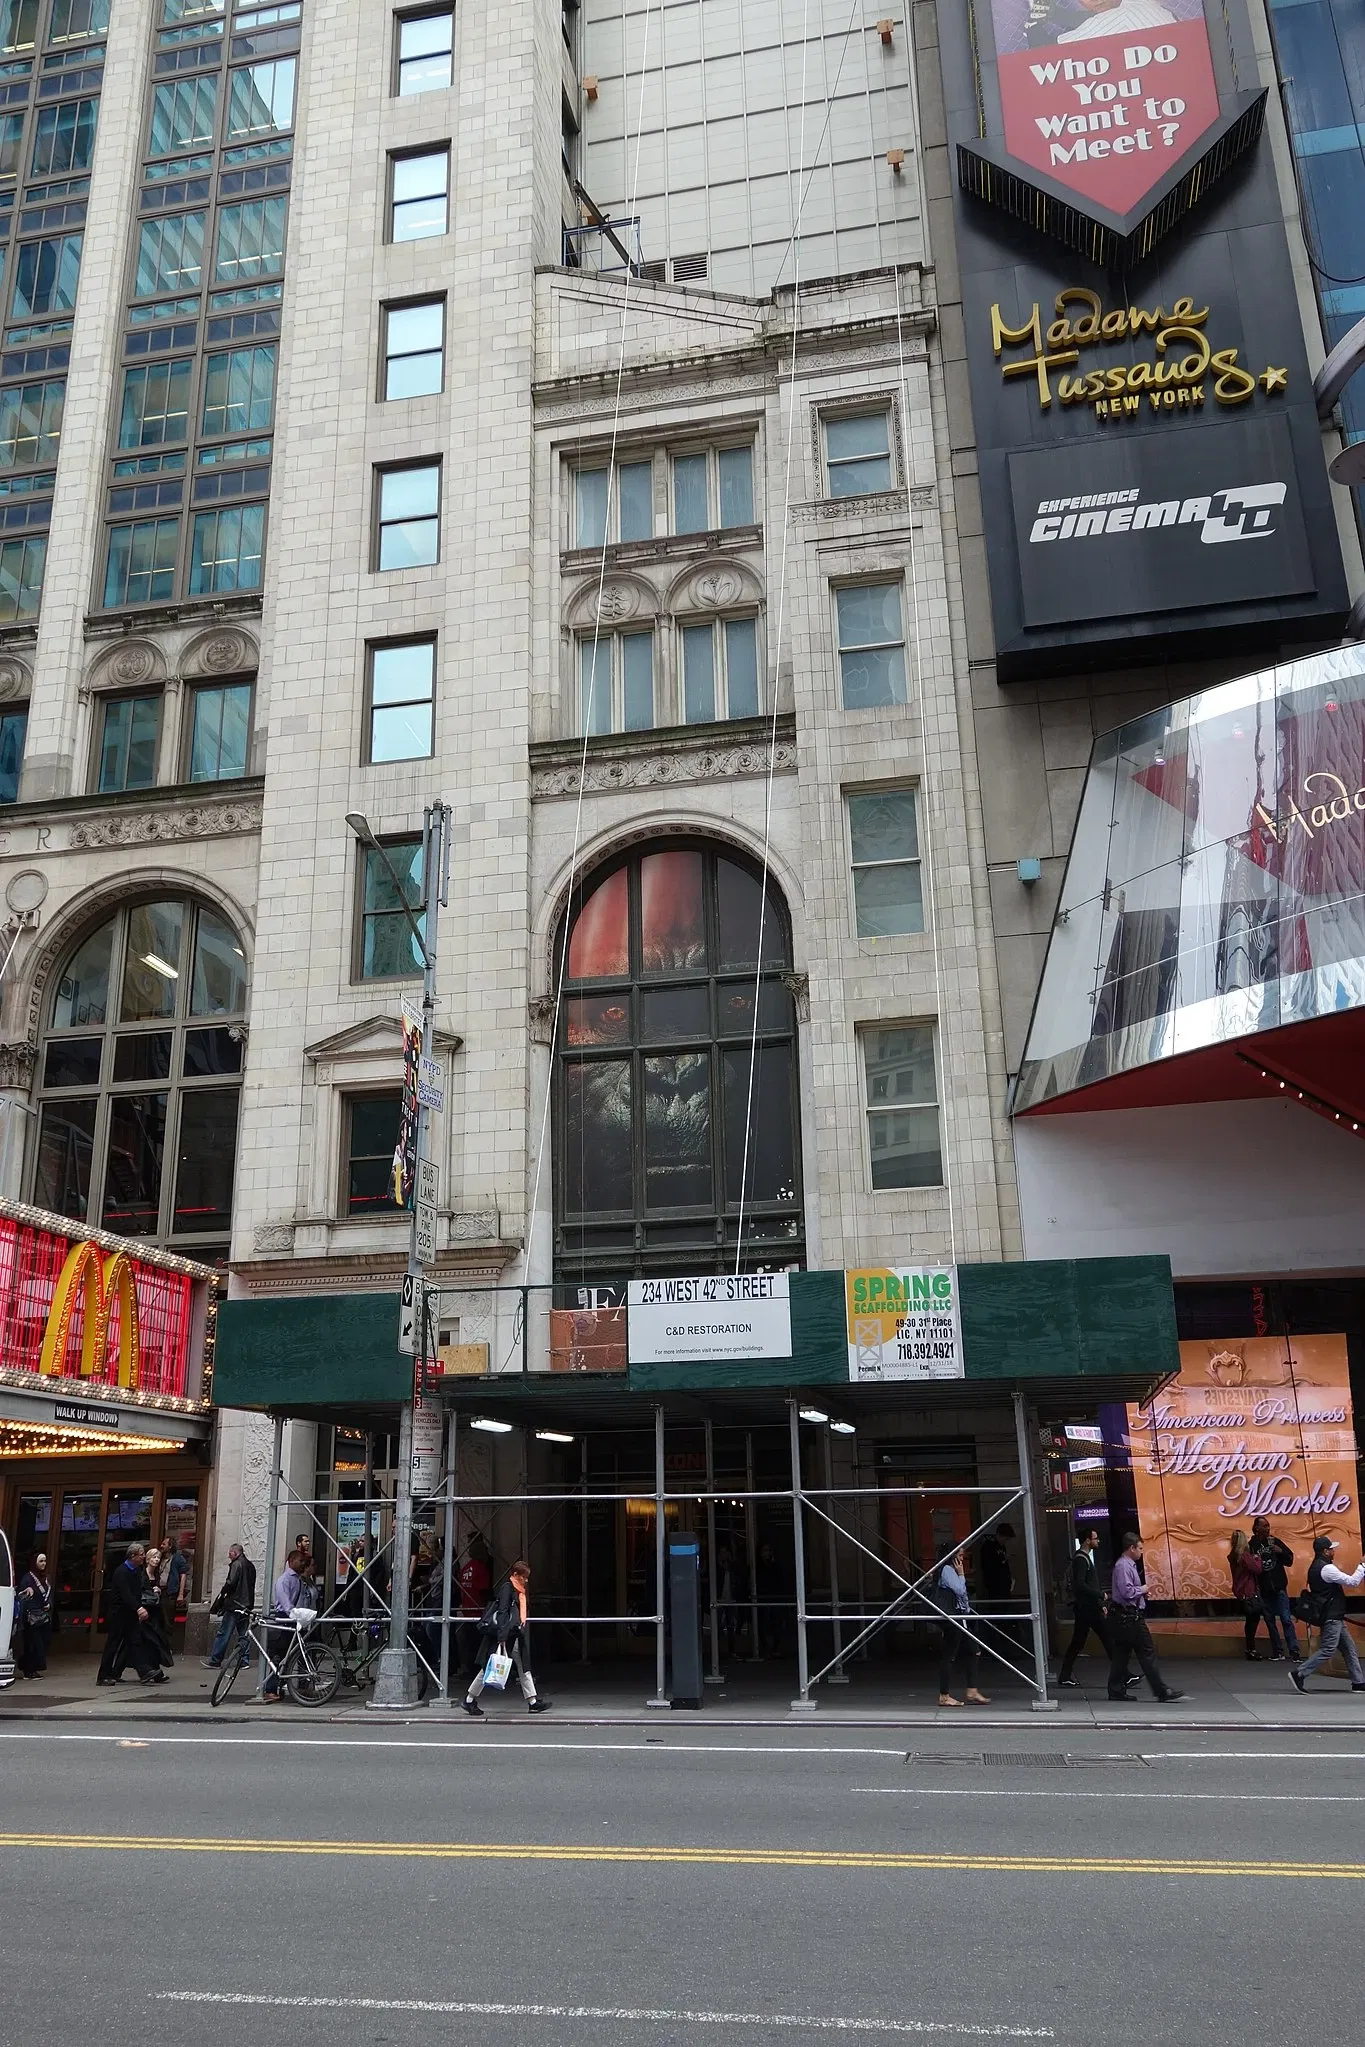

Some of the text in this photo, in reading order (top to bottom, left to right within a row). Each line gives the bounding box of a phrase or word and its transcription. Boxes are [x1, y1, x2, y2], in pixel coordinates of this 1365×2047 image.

[1029, 44, 1178, 86] Who Do
[1072, 77, 1142, 106] You
[1034, 98, 1186, 139] Want to
[990, 287, 1210, 356] Madame
[1002, 326, 1256, 409] Tussauds
[1095, 385, 1205, 418] NEW YORK
[1037, 487, 1140, 515] EXPERIENCE
[423, 1059, 441, 1076] NYPD
[418, 1079, 444, 1099] SECURITY
[419, 1089, 441, 1109] CAMERA
[422, 1165, 434, 1183] BUS
[420, 1183, 435, 1203] LANE
[419, 1206, 428, 1218] TOW
[421, 1219, 431, 1231] FINE
[641, 1282, 662, 1303] 234
[664, 1279, 700, 1302] WEST
[726, 1276, 775, 1299] STREET
[853, 1273, 951, 1302] SPRING
[854, 1299, 951, 1314] SCAFFOLDING LLC
[665, 1323, 752, 1336] C&D RESTORATION
[895, 1318, 916, 1328] 49-30
[932, 1317, 952, 1327] Place
[916, 1329, 926, 1339] NY
[929, 1328, 953, 1338] 11101
[897, 1342, 954, 1360] 718.392.4921
[858, 1365, 875, 1373] Permit
[416, 1397, 421, 1408] 3
[56, 1405, 115, 1424] WALK UP WINDOW
[1129, 1397, 1346, 1431] American Princess
[413, 1457, 419, 1468] 5
[1146, 1433, 1292, 1491] Meghan
[1218, 1474, 1351, 1517] Markle
